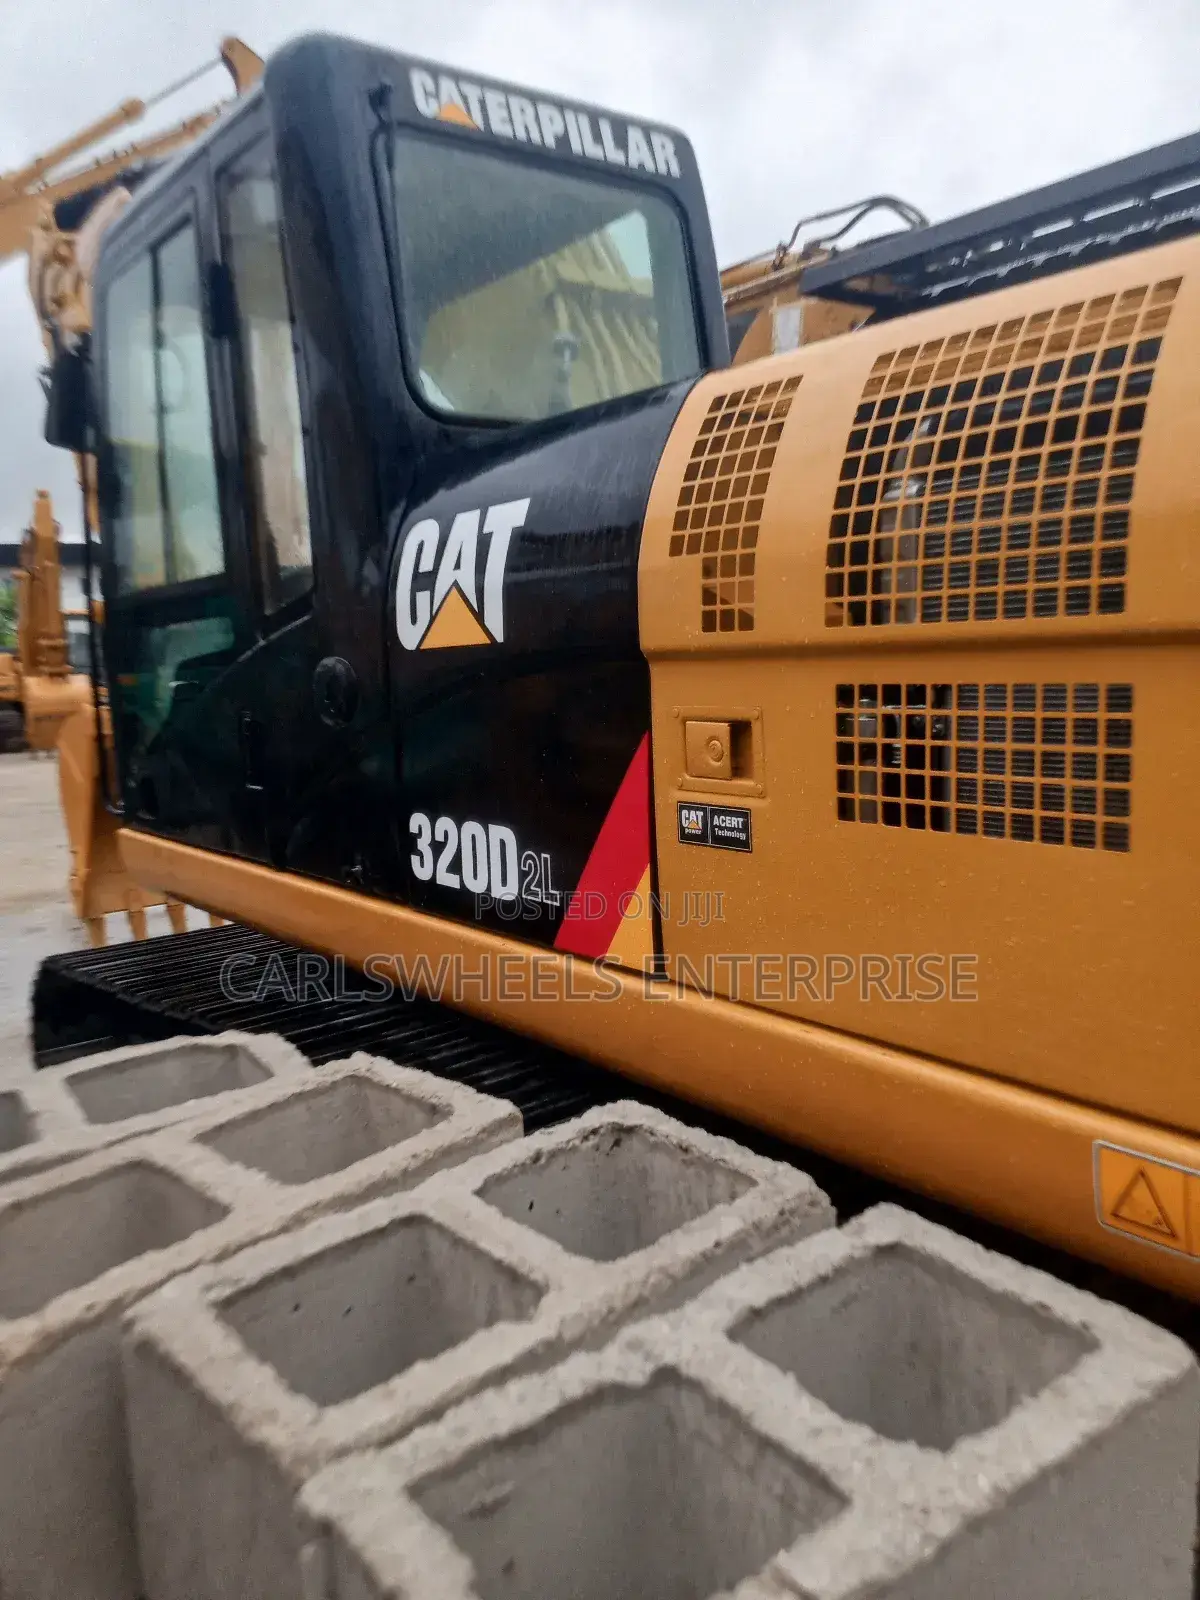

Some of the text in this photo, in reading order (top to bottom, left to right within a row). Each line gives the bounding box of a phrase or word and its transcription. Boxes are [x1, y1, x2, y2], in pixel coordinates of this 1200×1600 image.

[409, 67, 680, 179] CATERPILLAR
[395, 497, 531, 651] CAT
[681, 809, 704, 830] CAT
[713, 815, 744, 829] ACERT
[714, 828, 747, 841] Technology
